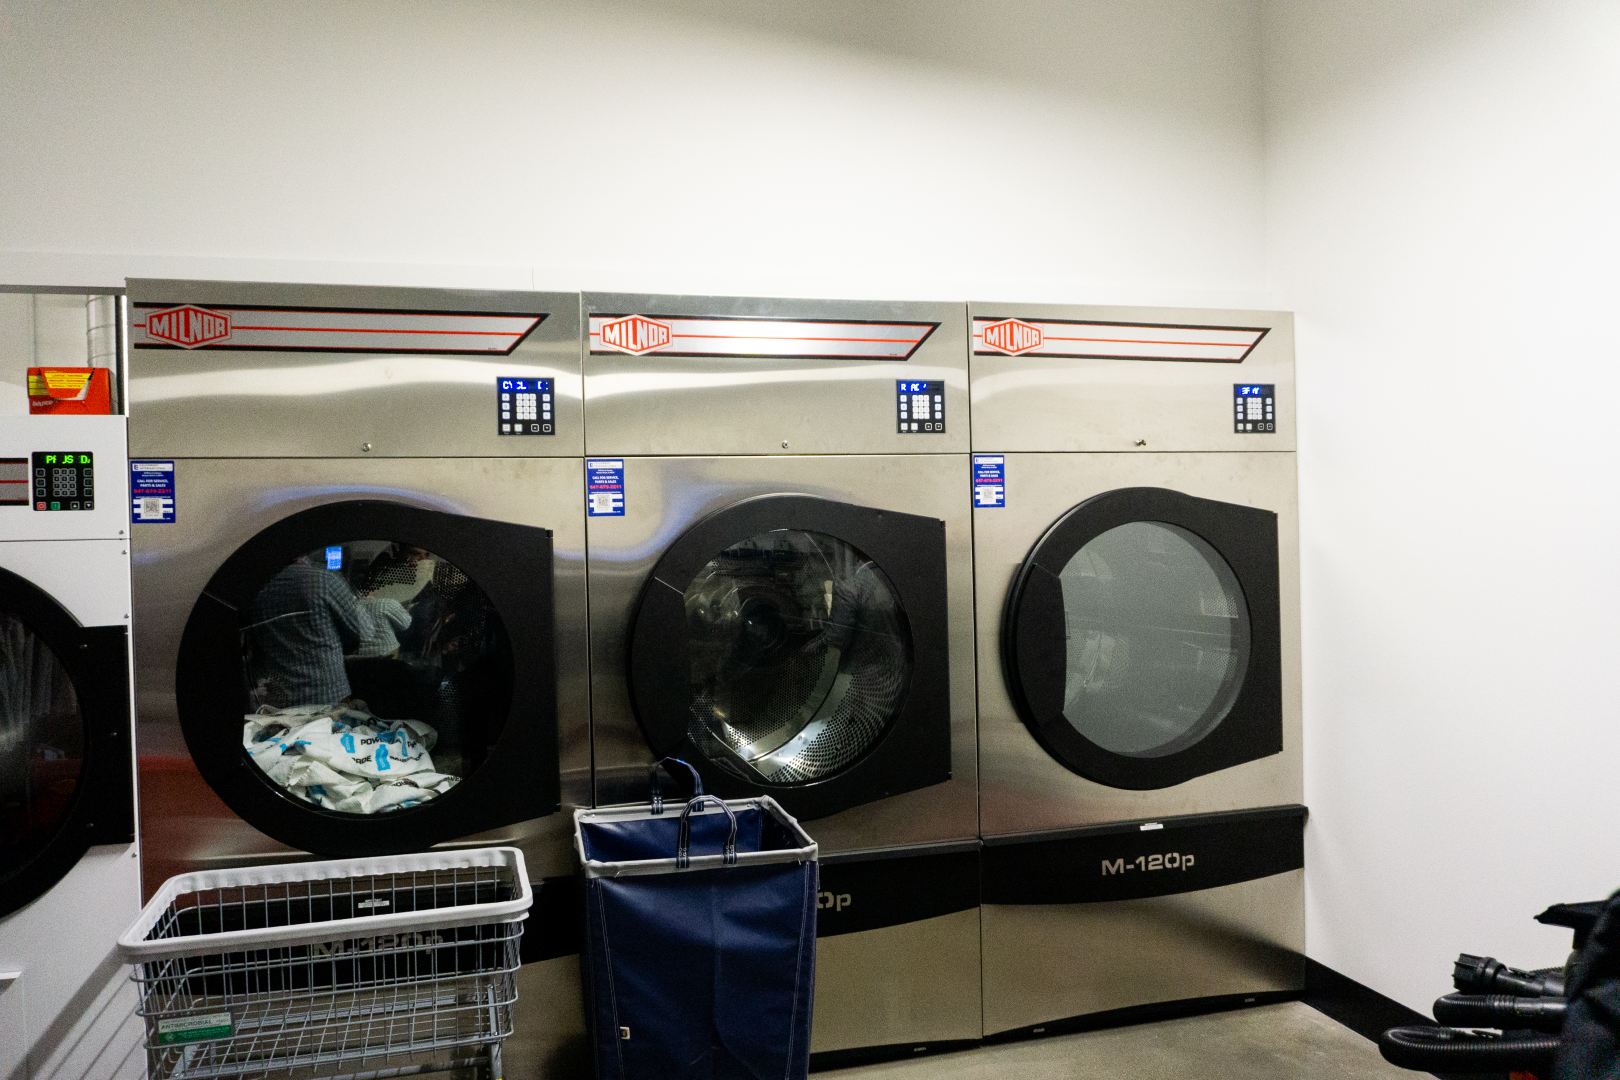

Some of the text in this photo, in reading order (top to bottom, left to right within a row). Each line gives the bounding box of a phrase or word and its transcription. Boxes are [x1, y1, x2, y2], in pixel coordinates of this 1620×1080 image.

[152, 310, 225, 343] MILNOR
[604, 320, 668, 350] MILNOR
[986, 323, 1039, 351] MILNOR
[1101, 852, 1195, 876] M-120p
